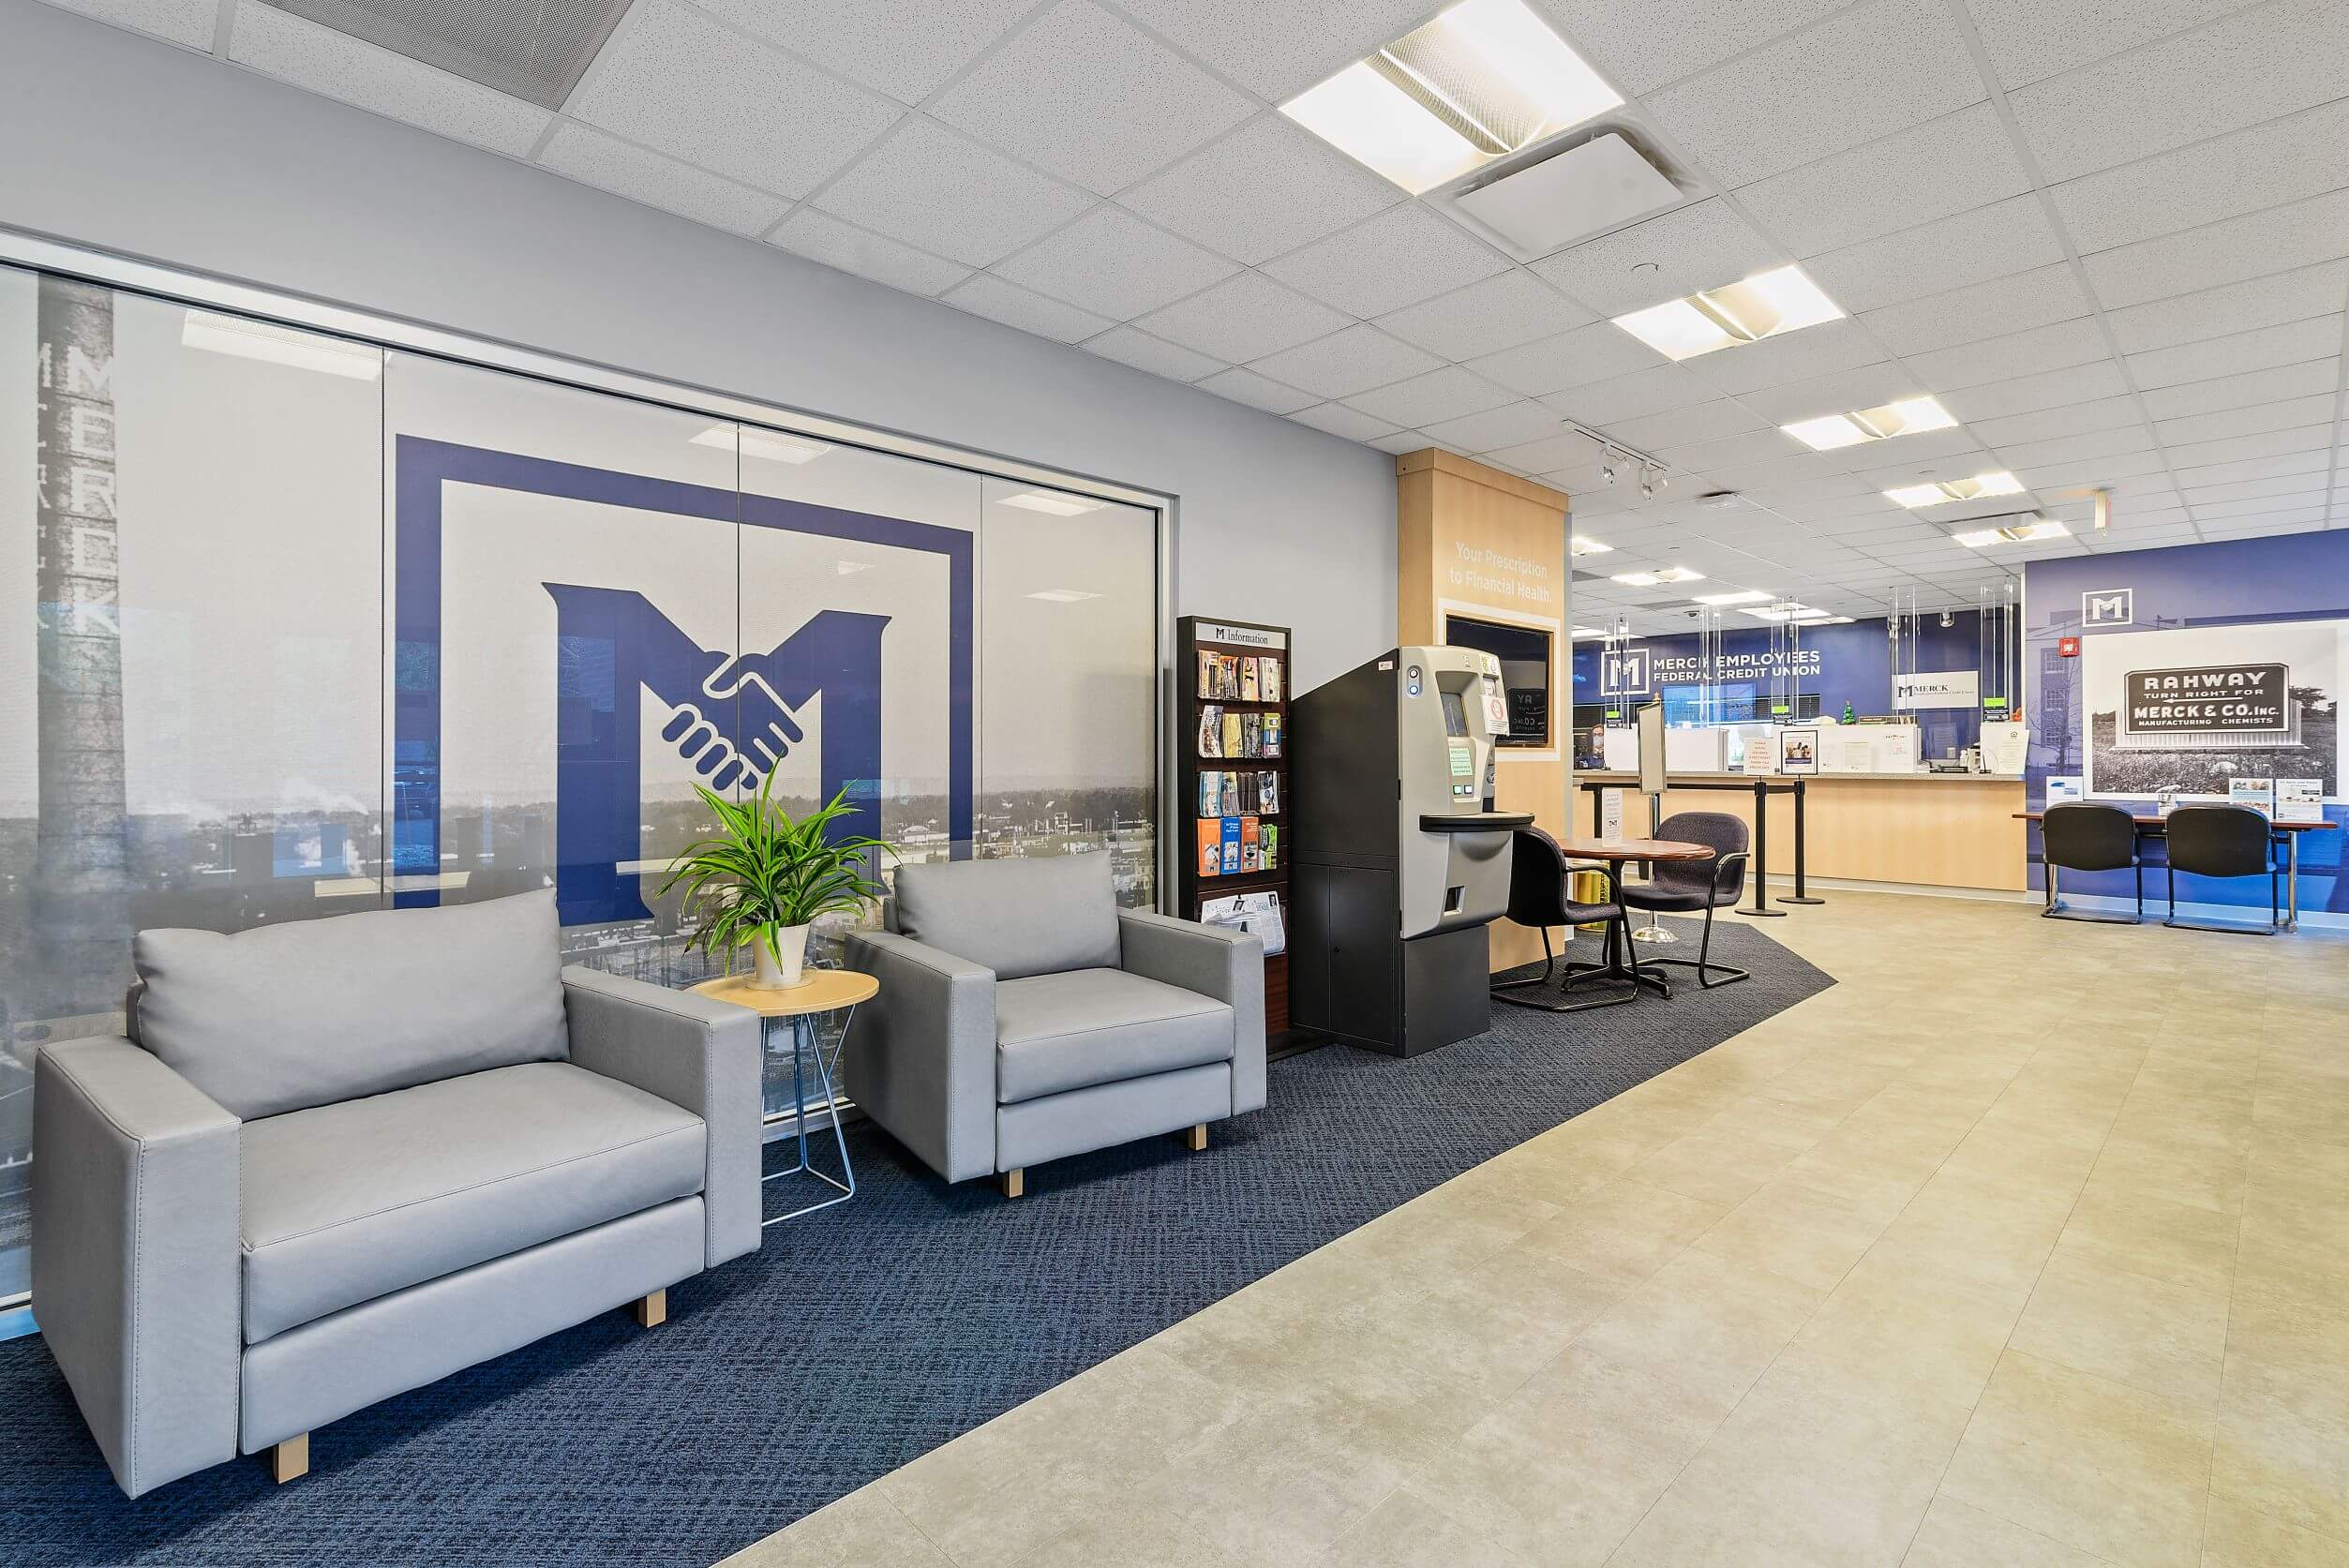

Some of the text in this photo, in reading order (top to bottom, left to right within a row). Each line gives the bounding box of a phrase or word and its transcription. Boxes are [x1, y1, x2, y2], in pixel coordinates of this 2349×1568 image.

[1456, 541, 1547, 577] Your Prescription
[1448, 566, 1552, 604] to Financial Health.
[2091, 596, 2123, 620] M
[1228, 629, 1268, 645] Information
[1715, 650, 1820, 668] EMPLOYEES
[1653, 665, 1820, 682] FEDERAL CREDIT UNION
[2144, 671, 2267, 691] RAHWAY
[2133, 705, 2199, 719] MERCK
[2204, 704, 2217, 717] &
[2222, 716, 2273, 724] CHEMISTS
